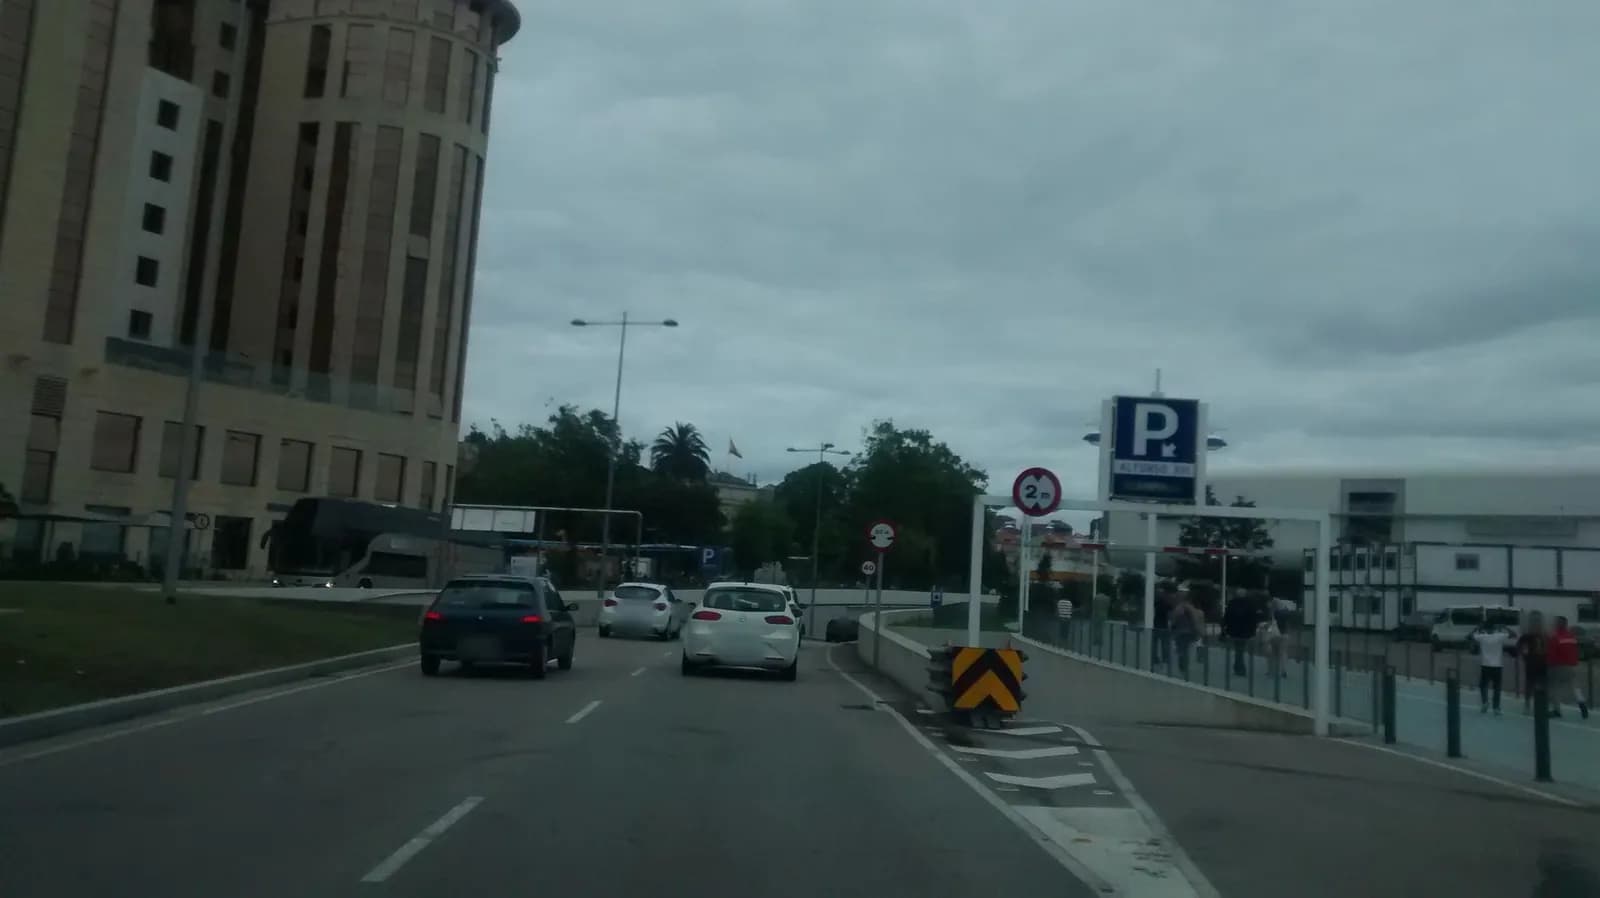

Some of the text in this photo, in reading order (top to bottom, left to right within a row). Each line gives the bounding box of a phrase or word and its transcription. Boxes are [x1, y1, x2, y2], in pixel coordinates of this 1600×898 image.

[1132, 403, 1179, 456] P
[1024, 484, 1038, 499] 2
[703, 547, 714, 563] P
